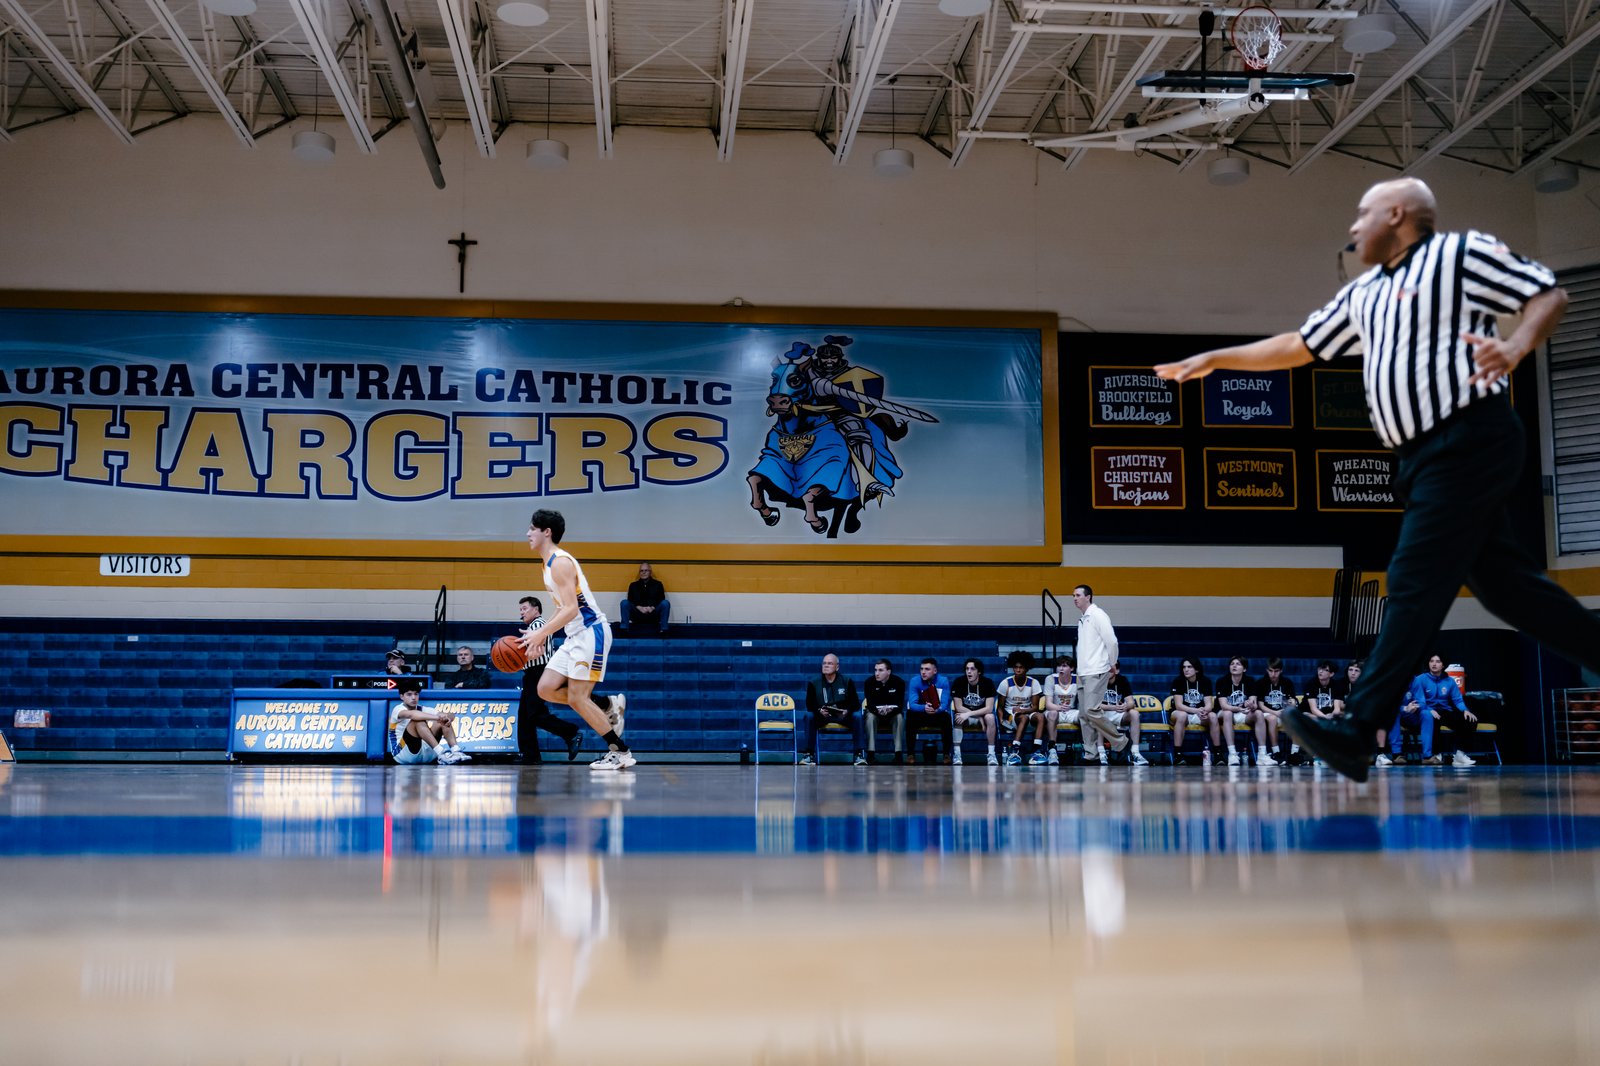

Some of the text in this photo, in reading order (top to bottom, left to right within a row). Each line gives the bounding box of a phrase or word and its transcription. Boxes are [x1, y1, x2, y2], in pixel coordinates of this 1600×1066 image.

[211, 363, 458, 401] CENTRAL
[475, 367, 732, 405] CATHOLIC
[1103, 374, 1168, 390] RIVERSIDE
[1221, 379, 1273, 393] ROSARY
[1099, 391, 1173, 403] BROOKFIELD
[1101, 404, 1172, 426] Bulldogs
[1223, 400, 1273, 421] Royals
[0, 400, 730, 502] CHARGERS
[1108, 455, 1167, 469] TIMOTHY
[1216, 460, 1284, 475] WESTMONT
[1333, 459, 1390, 473] WHEATON
[1104, 471, 1173, 484] CHRISTIAN
[1334, 474, 1391, 485] ACADEMY
[1108, 484, 1170, 507] Trojans
[1217, 481, 1285, 498] Sentinels
[1332, 486, 1395, 503] Warriors
[108, 555, 183, 574] VISITORS
[265, 702, 339, 714] WELCOME TO
[434, 703, 510, 714] HOME OF THE
[763, 694, 789, 707] ACC
[236, 714, 364, 732] AURORA CENTRAL
[264, 733, 336, 750] CATHOLIC
